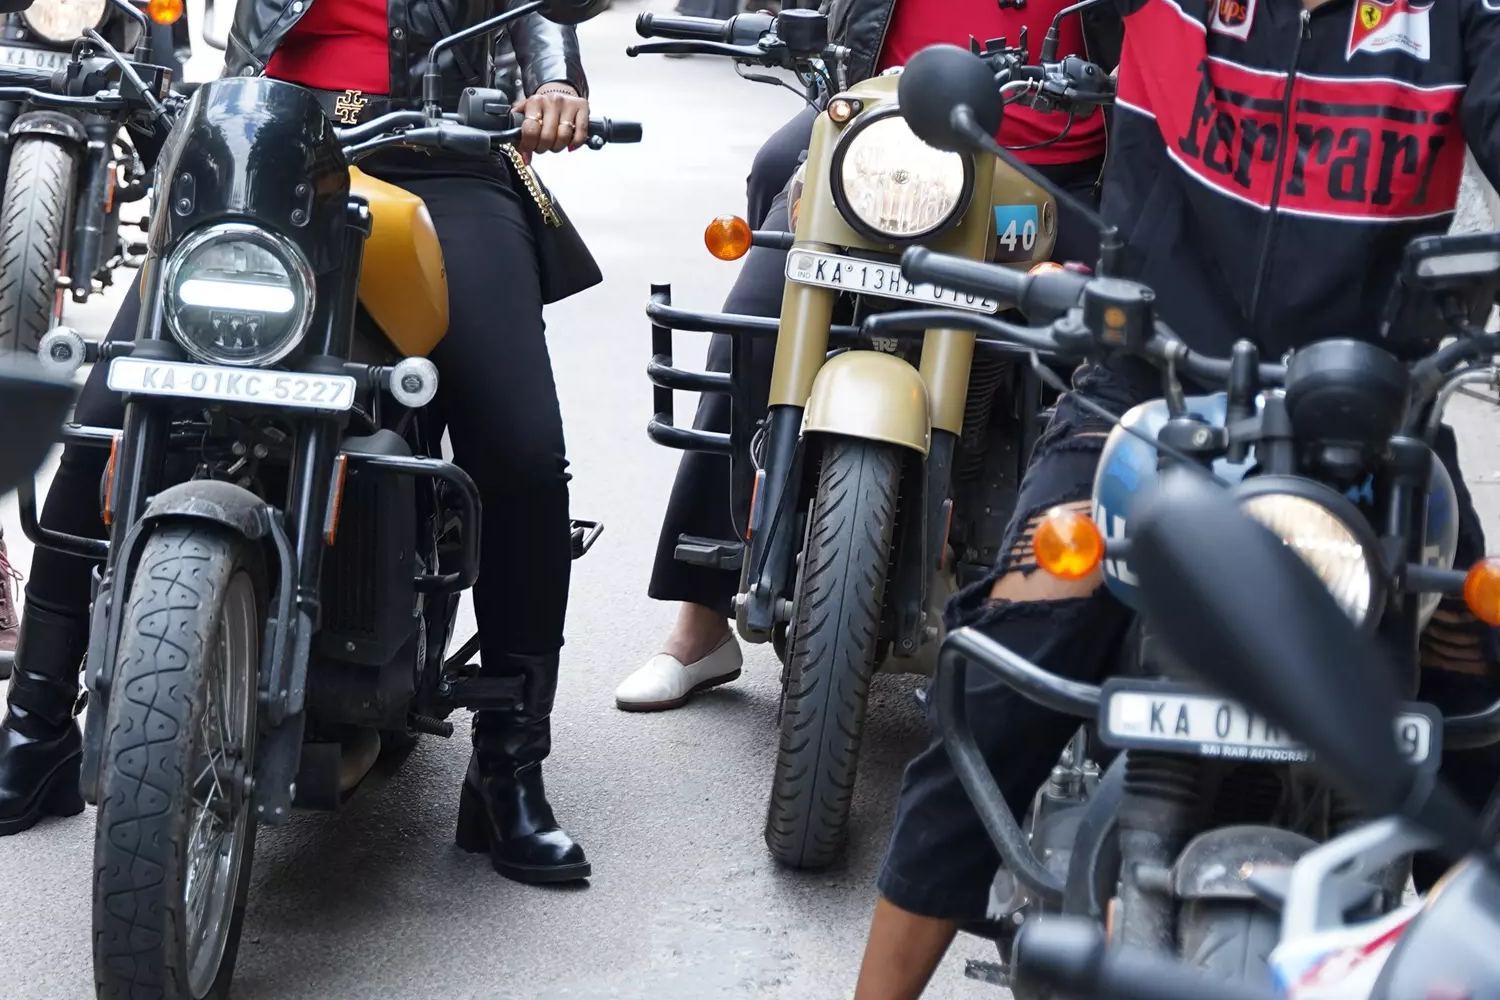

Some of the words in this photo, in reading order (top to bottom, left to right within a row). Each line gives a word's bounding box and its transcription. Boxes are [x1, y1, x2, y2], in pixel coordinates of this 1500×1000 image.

[1220, 0, 1246, 22] ups
[7, 49, 27, 65] KA
[1178, 60, 1454, 206] Ferrari
[1000, 219, 1036, 251] 40
[816, 259, 842, 284] KA
[142, 366, 176, 390] KA
[190, 372, 261, 397] 01KC
[274, 376, 347, 404] 5227
[1150, 701, 1190, 736] KA
[1201, 743, 1221, 756] SAI
[1222, 745, 1249, 758] RAM
